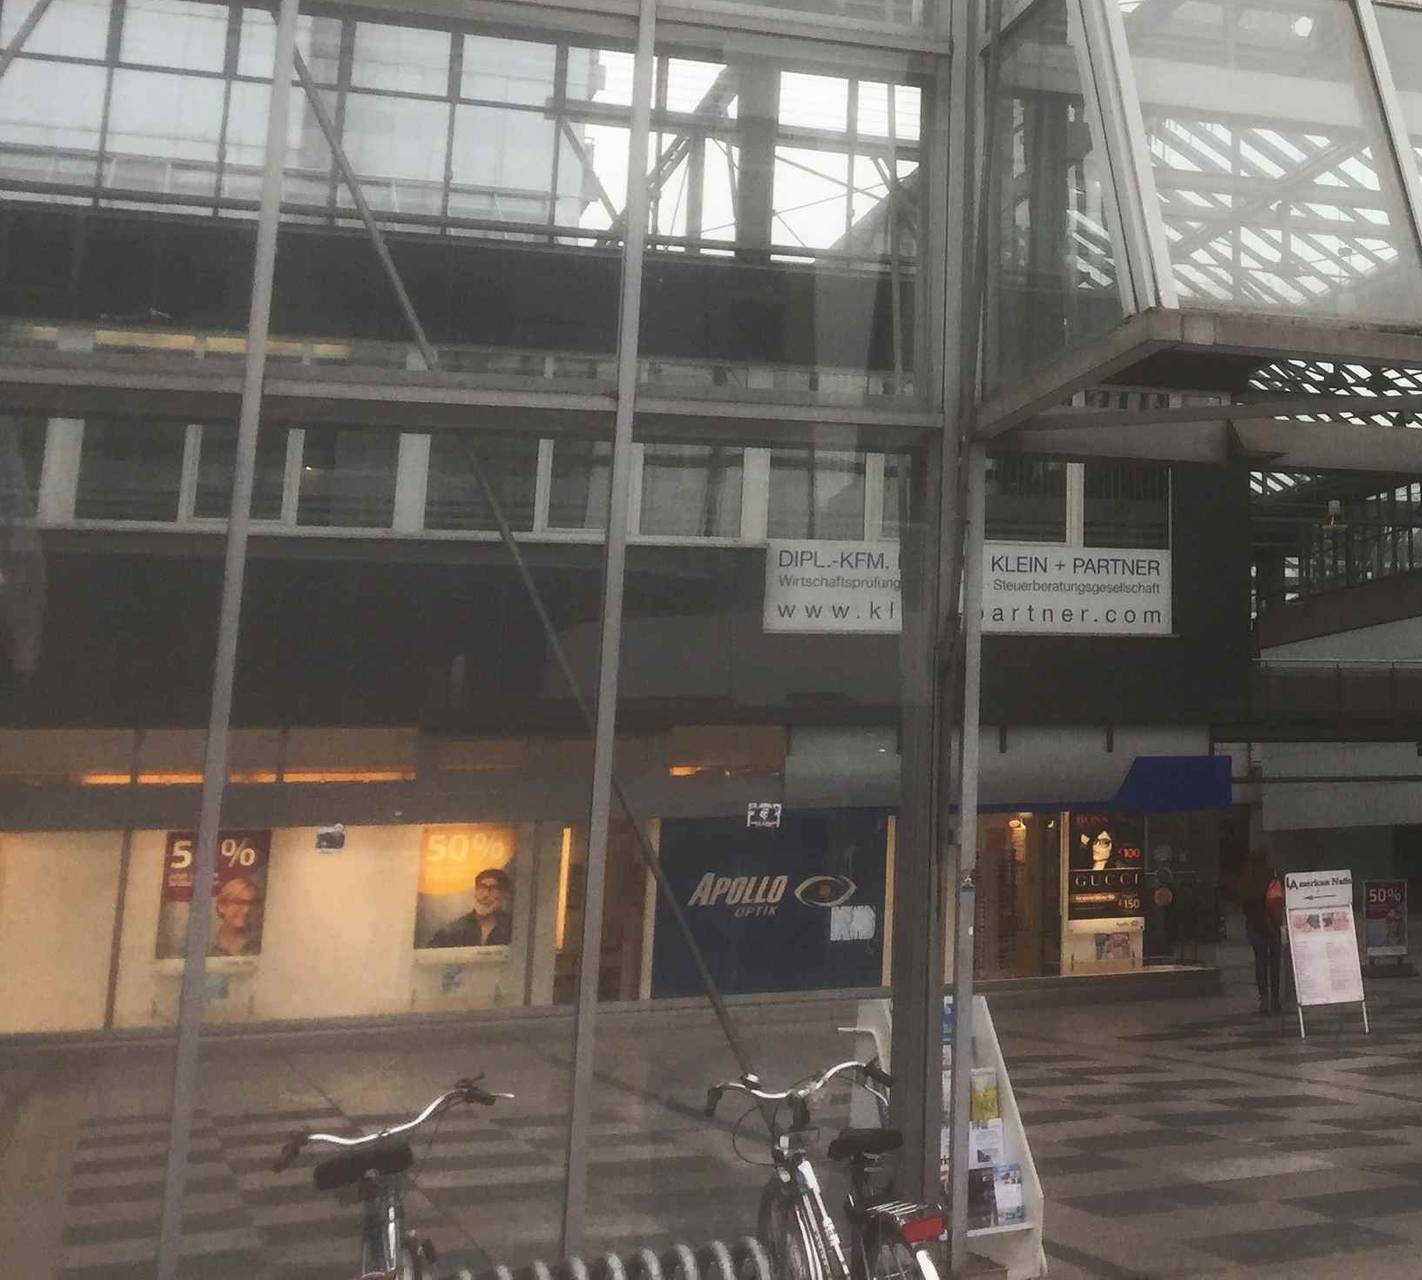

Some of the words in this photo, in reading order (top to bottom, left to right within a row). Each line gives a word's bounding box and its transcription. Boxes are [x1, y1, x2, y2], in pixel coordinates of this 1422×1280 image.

[778, 550, 889, 570] DIPL.-KFM.
[991, 556, 1048, 573] KLEIN
[1055, 560, 1065, 571] +
[1073, 558, 1161, 576] PARTNER
[170, 837, 256, 869] 5%
[427, 832, 505, 862] 50%
[688, 872, 789, 906] APOLLO
[1075, 873, 1139, 887] GUCCI
[1369, 887, 1400, 903] 50%
[734, 906, 777, 918] OPTIK
